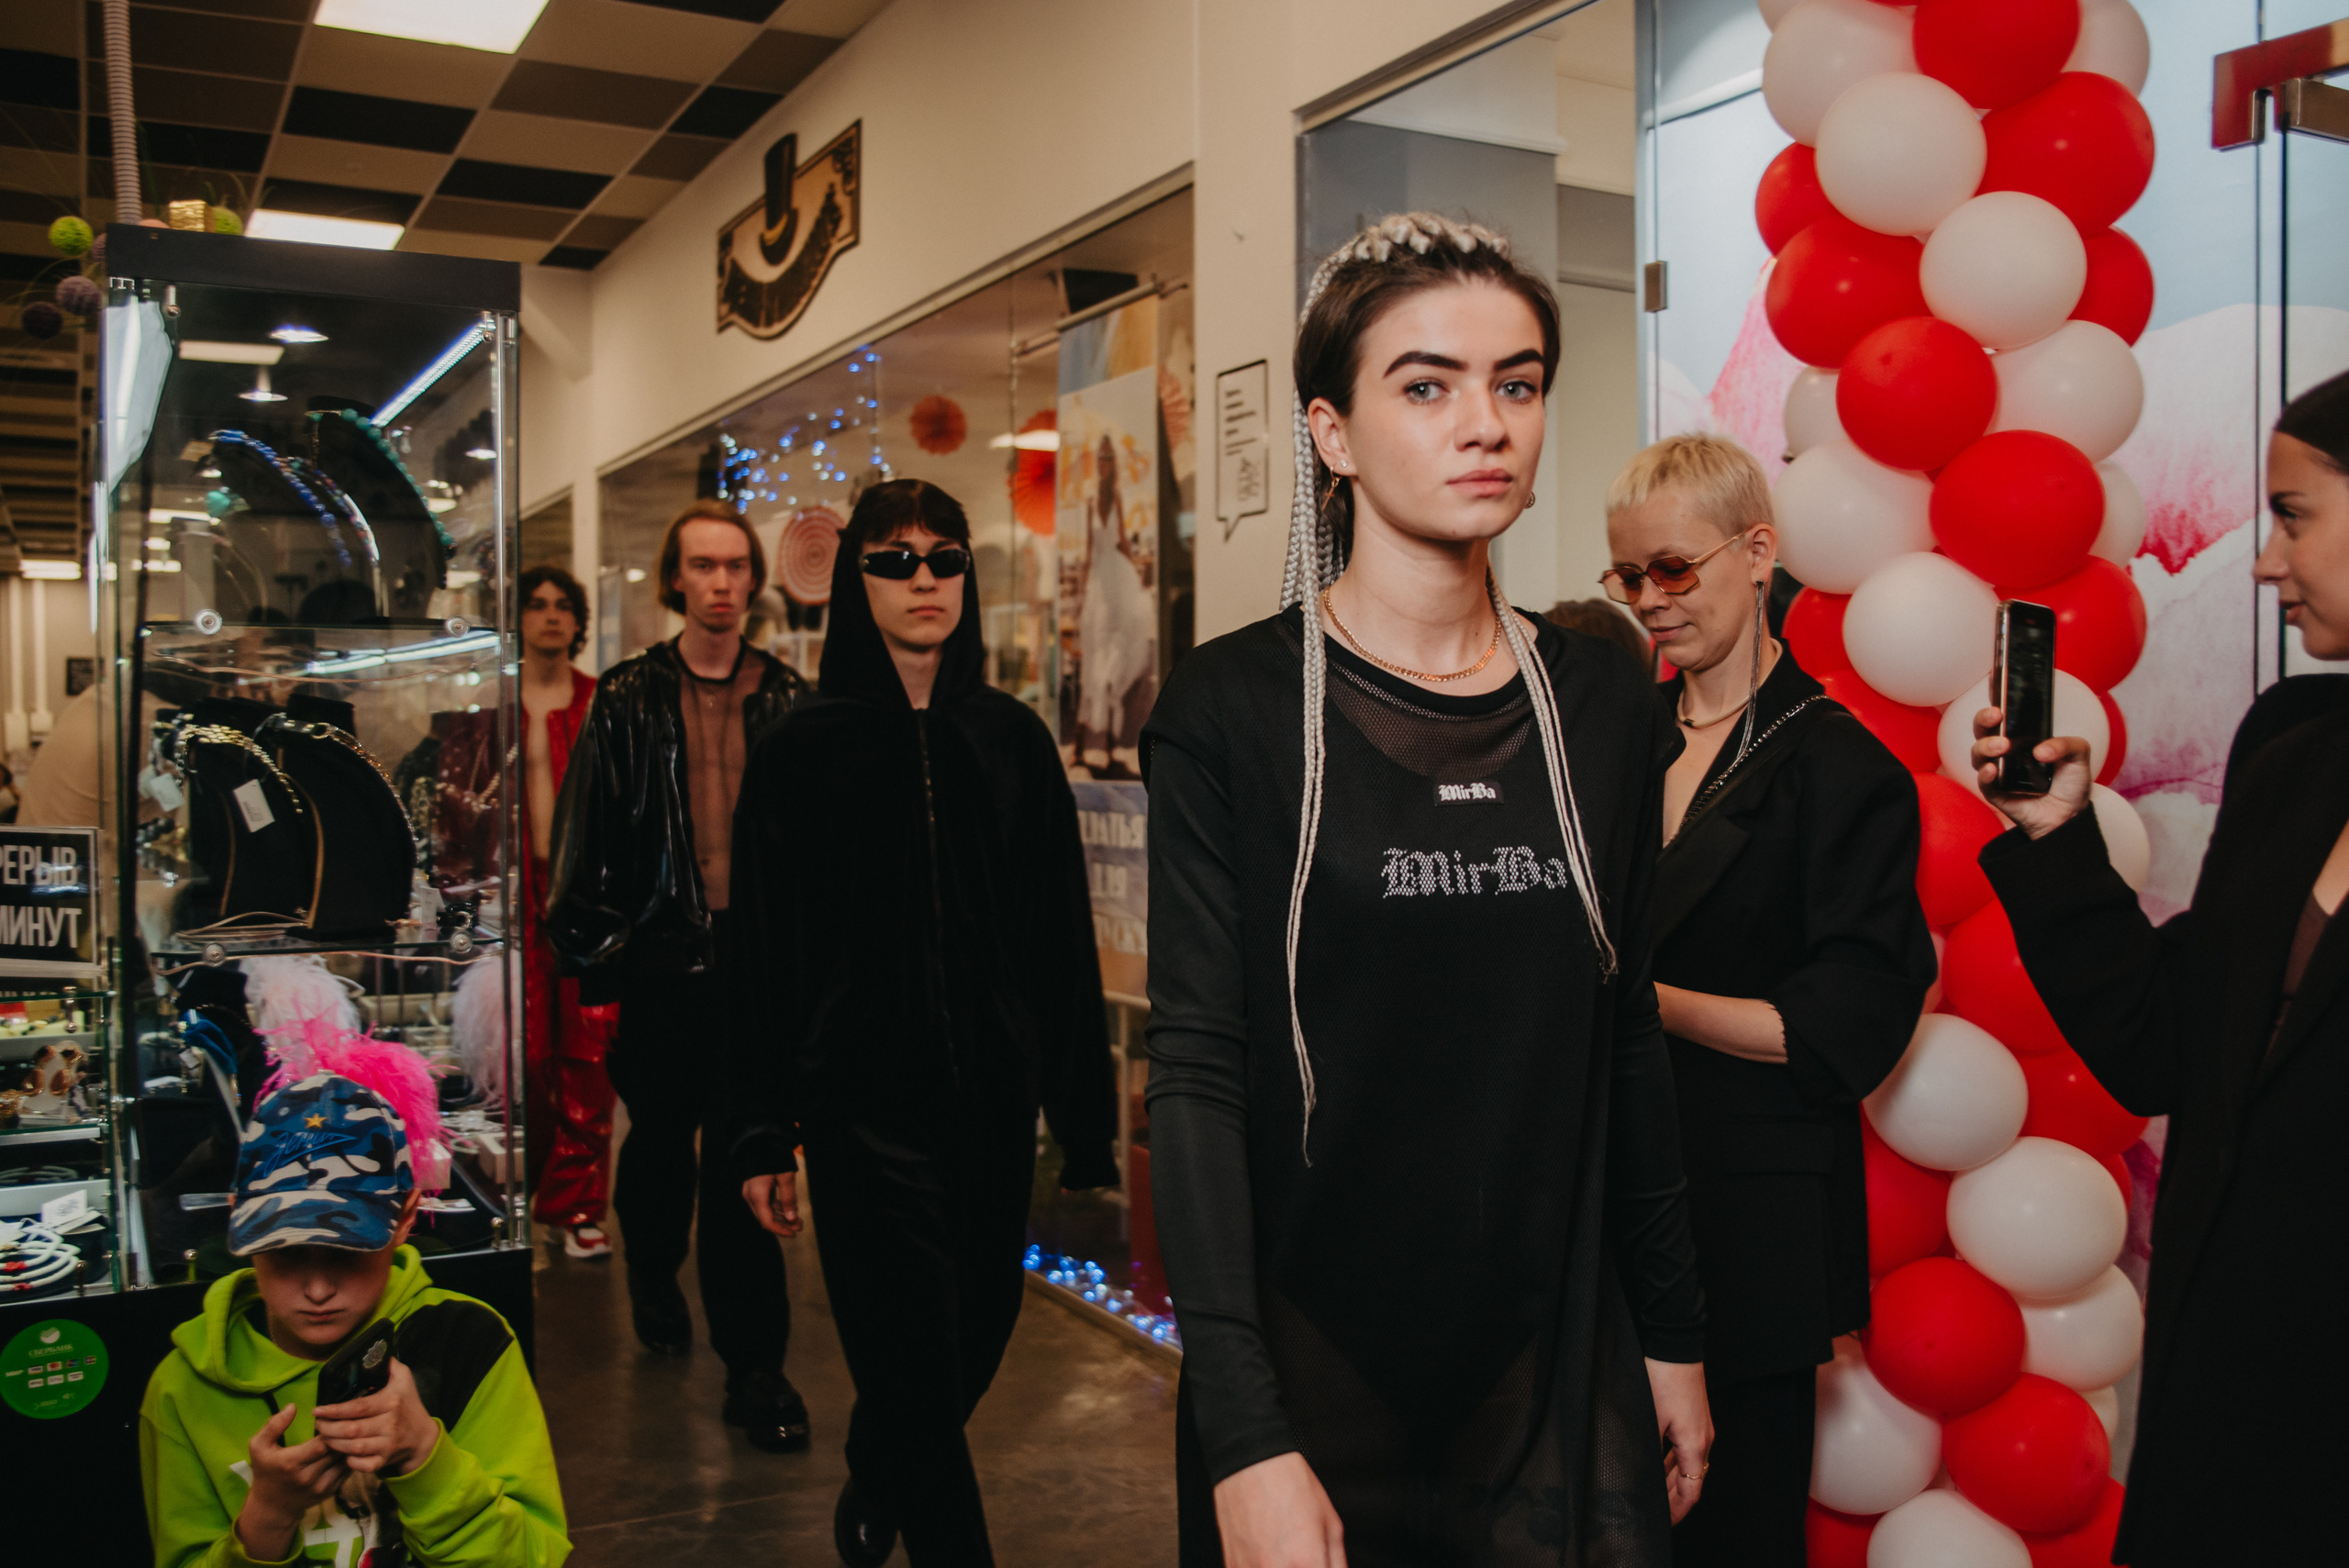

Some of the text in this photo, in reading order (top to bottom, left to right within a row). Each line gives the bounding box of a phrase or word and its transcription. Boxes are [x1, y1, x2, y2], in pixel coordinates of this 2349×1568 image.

[1438, 783, 1496, 801] MirBa
[0, 845, 78, 886] ЕРЫВ
[1381, 846, 1568, 899] MirBa
